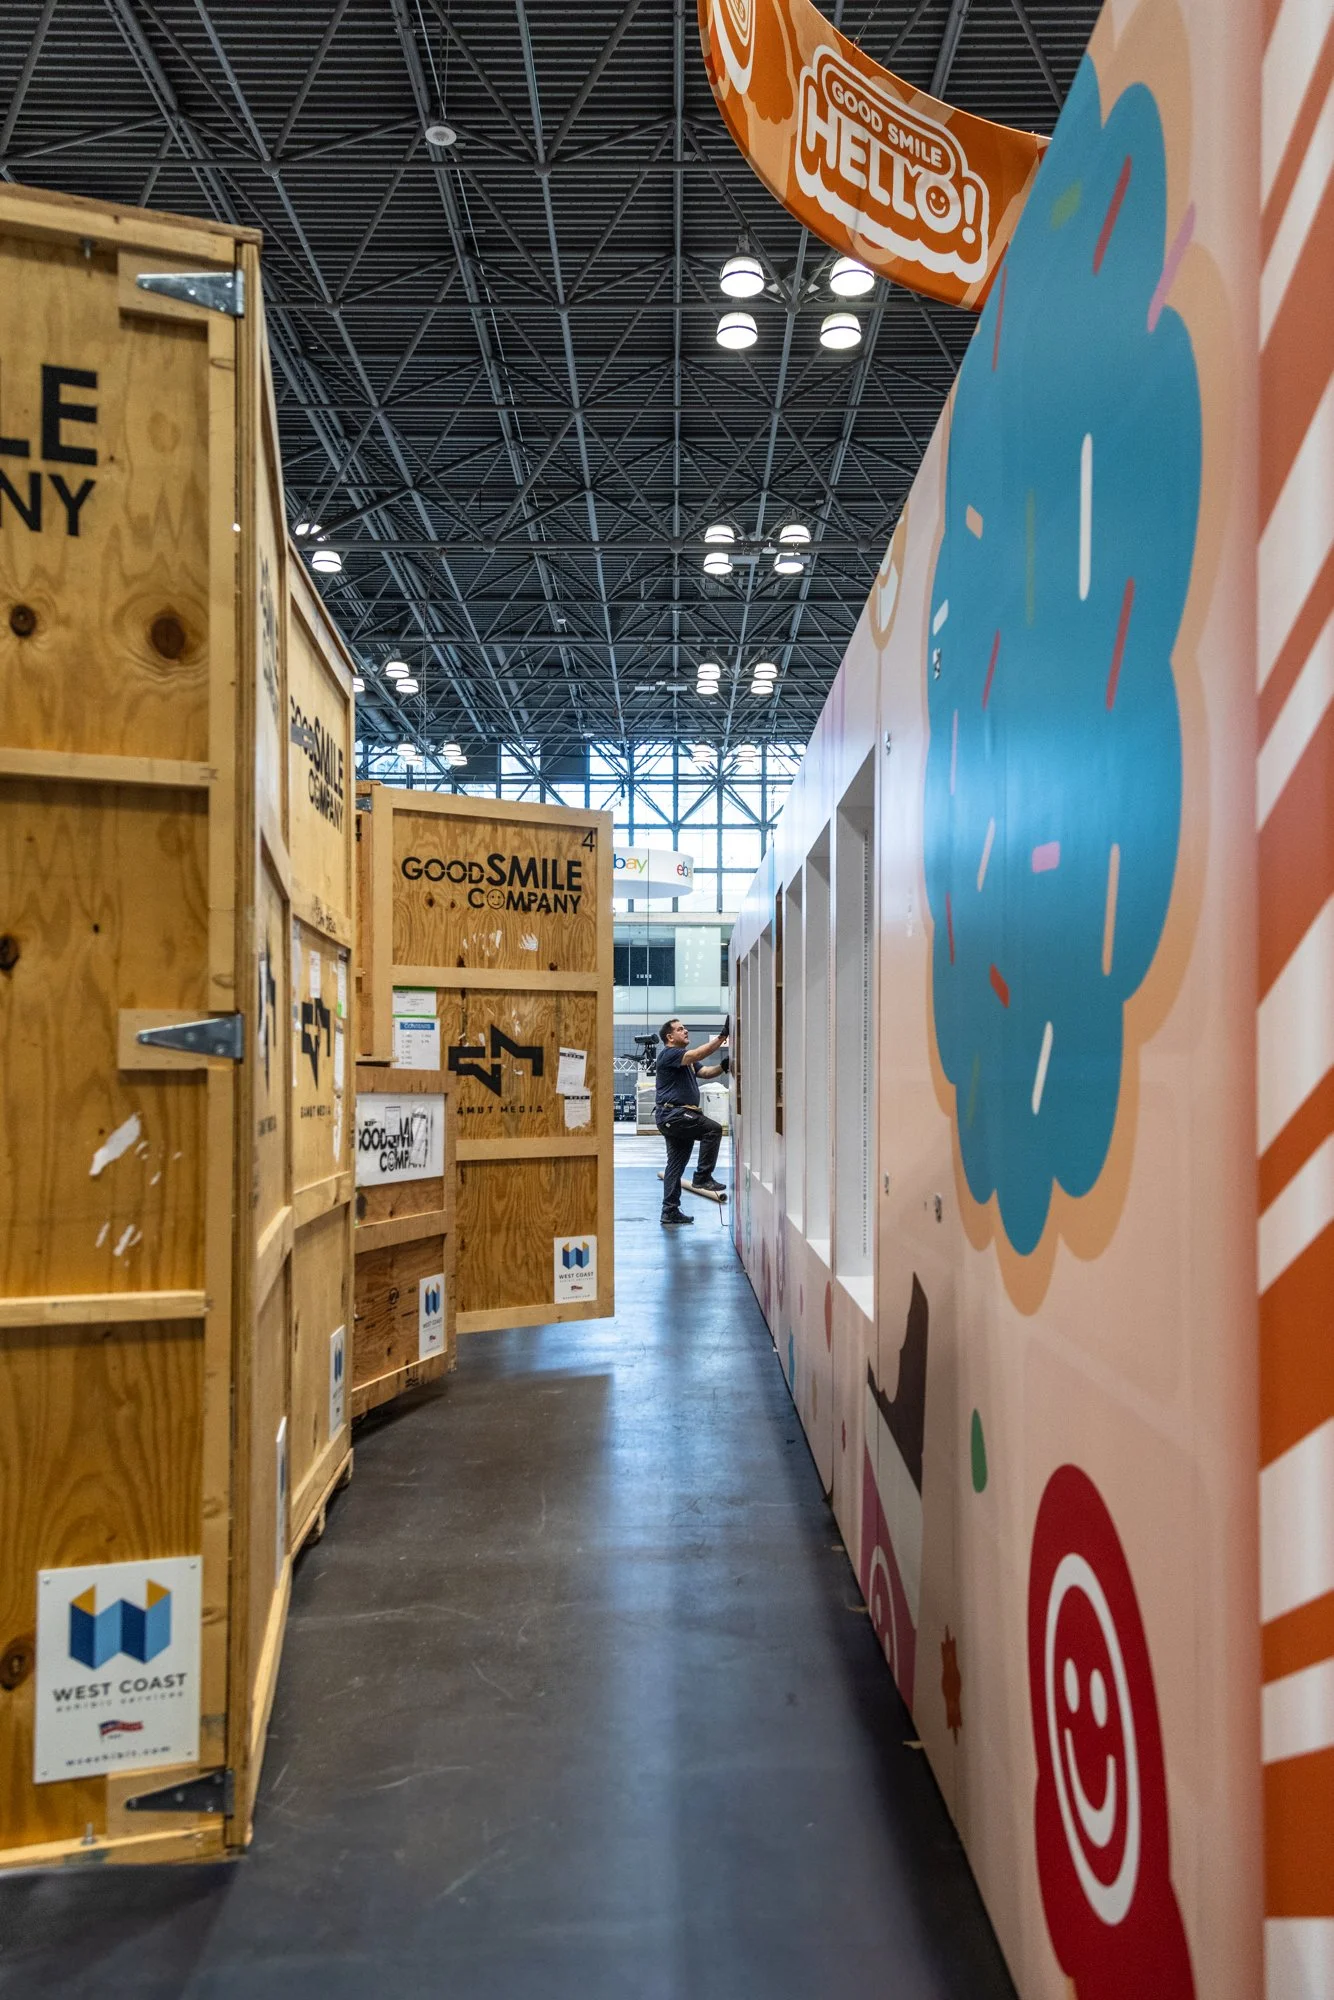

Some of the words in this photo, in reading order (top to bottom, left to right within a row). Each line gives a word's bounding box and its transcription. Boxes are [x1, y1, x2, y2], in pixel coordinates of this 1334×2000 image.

[831, 80, 883, 133] GOOD
[887, 122, 943, 169] SMILE
[0, 360, 98, 467] E
[0, 470, 97, 538] NY
[581, 829, 596, 852] 4
[467, 887, 582, 914] COMPANY
[500, 1105, 544, 1114] MEDIA
[53, 1682, 112, 1702] WEST
[119, 1672, 188, 1694] COAST
